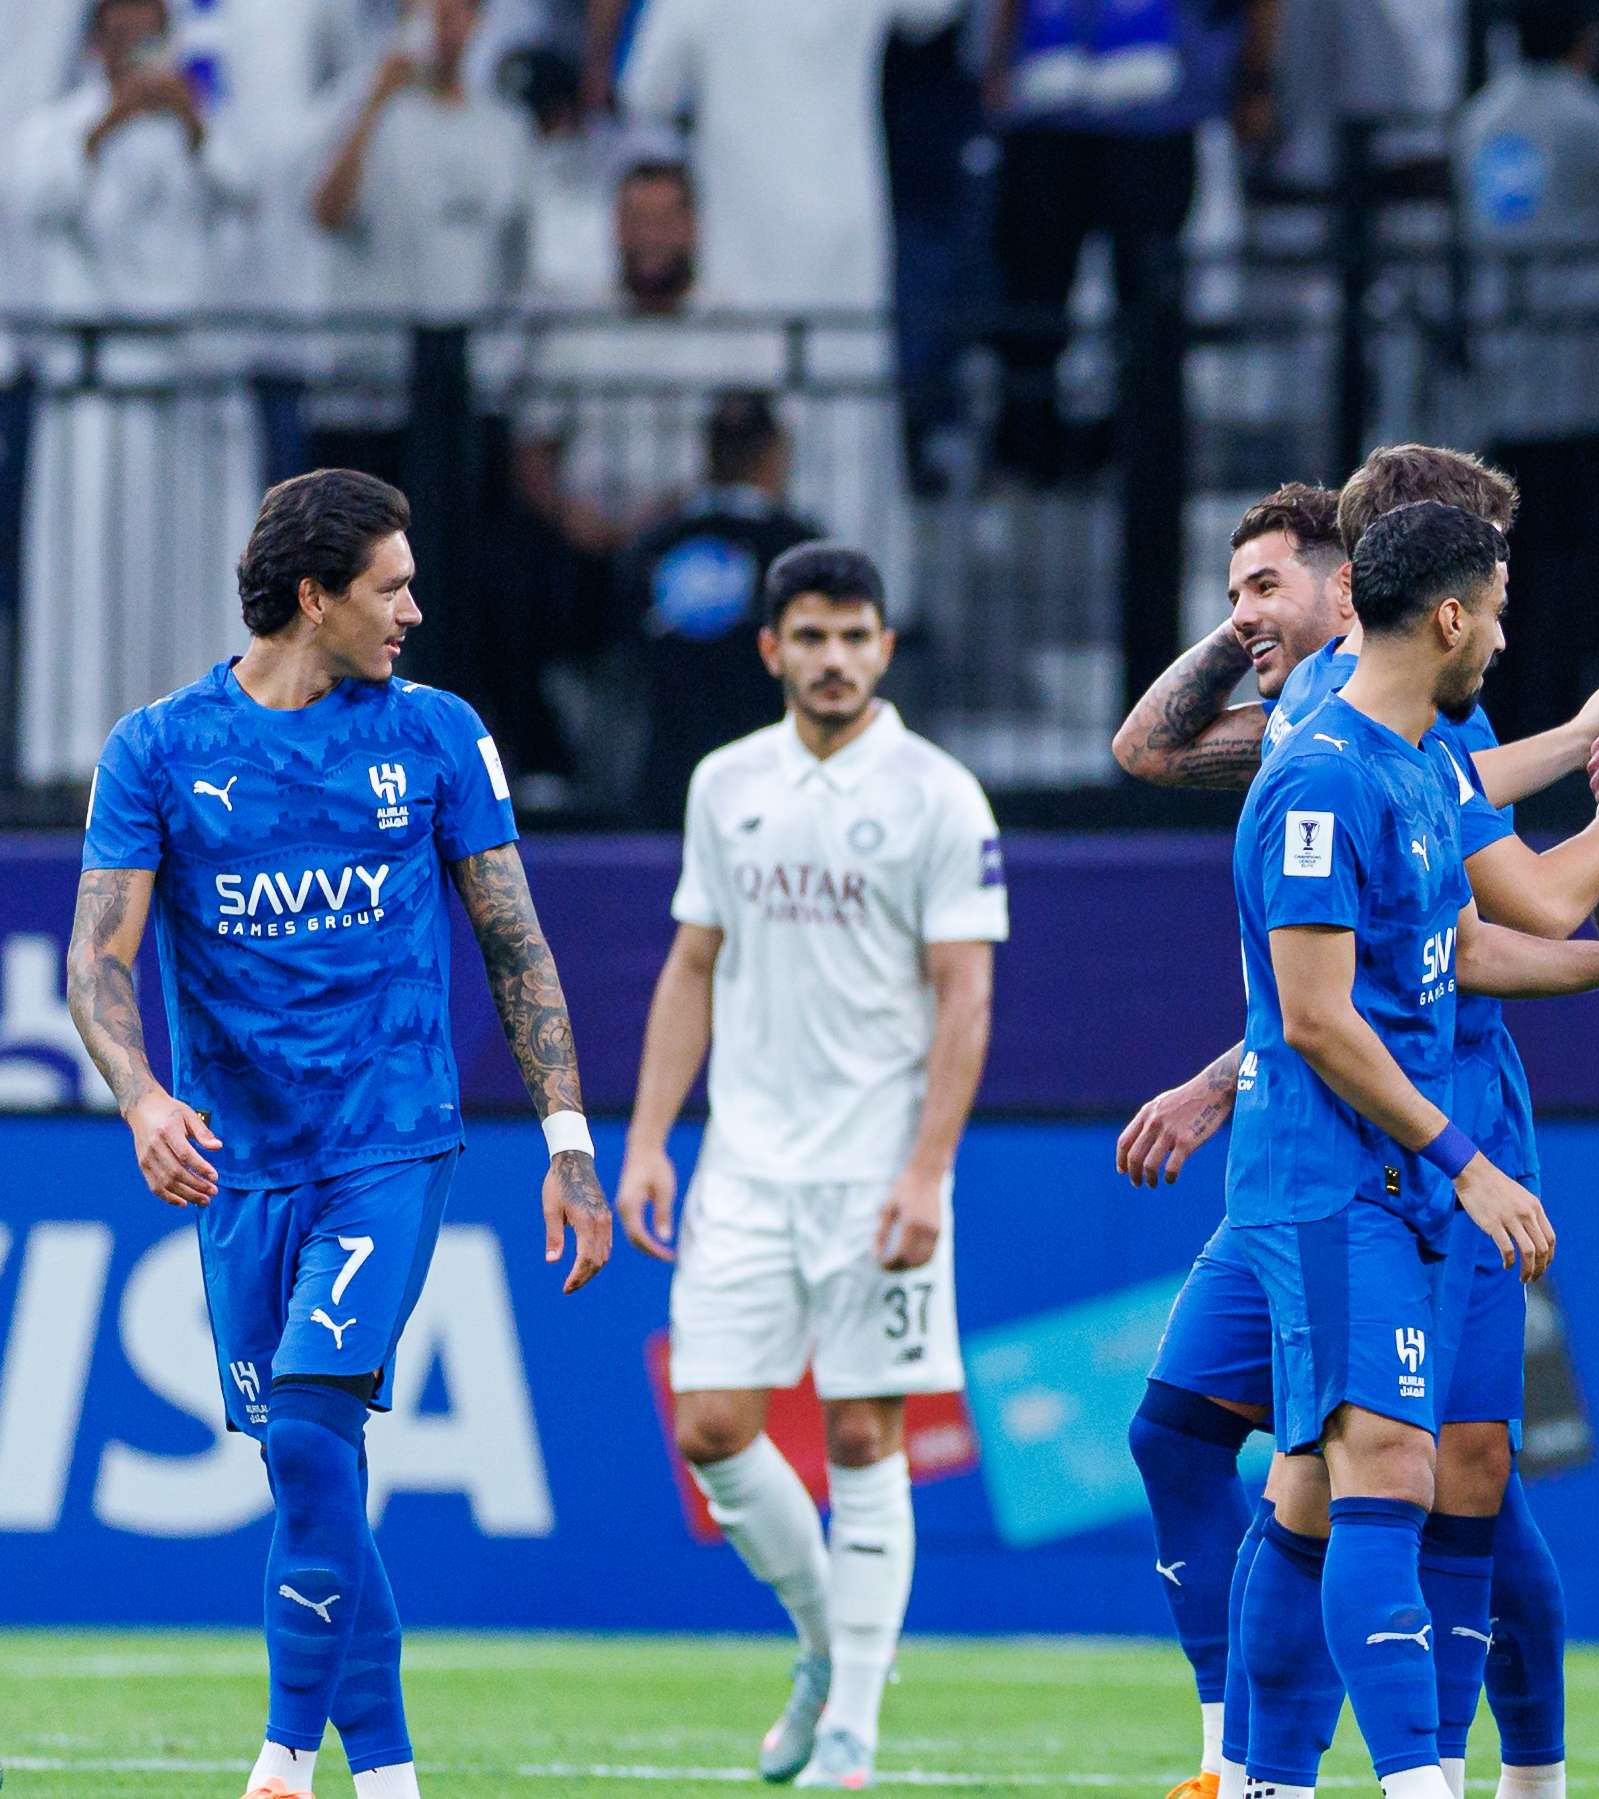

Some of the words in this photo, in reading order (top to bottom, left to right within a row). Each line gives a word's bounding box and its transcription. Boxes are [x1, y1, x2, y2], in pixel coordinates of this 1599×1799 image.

[215, 864, 390, 917] SAVVY
[734, 861, 867, 909] QATAR
[218, 920, 296, 937] GAMES
[307, 908, 385, 931] GROUP
[337, 1235, 375, 1306] 7
[882, 1282, 935, 1339] 37
[0, 1221, 557, 1538] ISA
